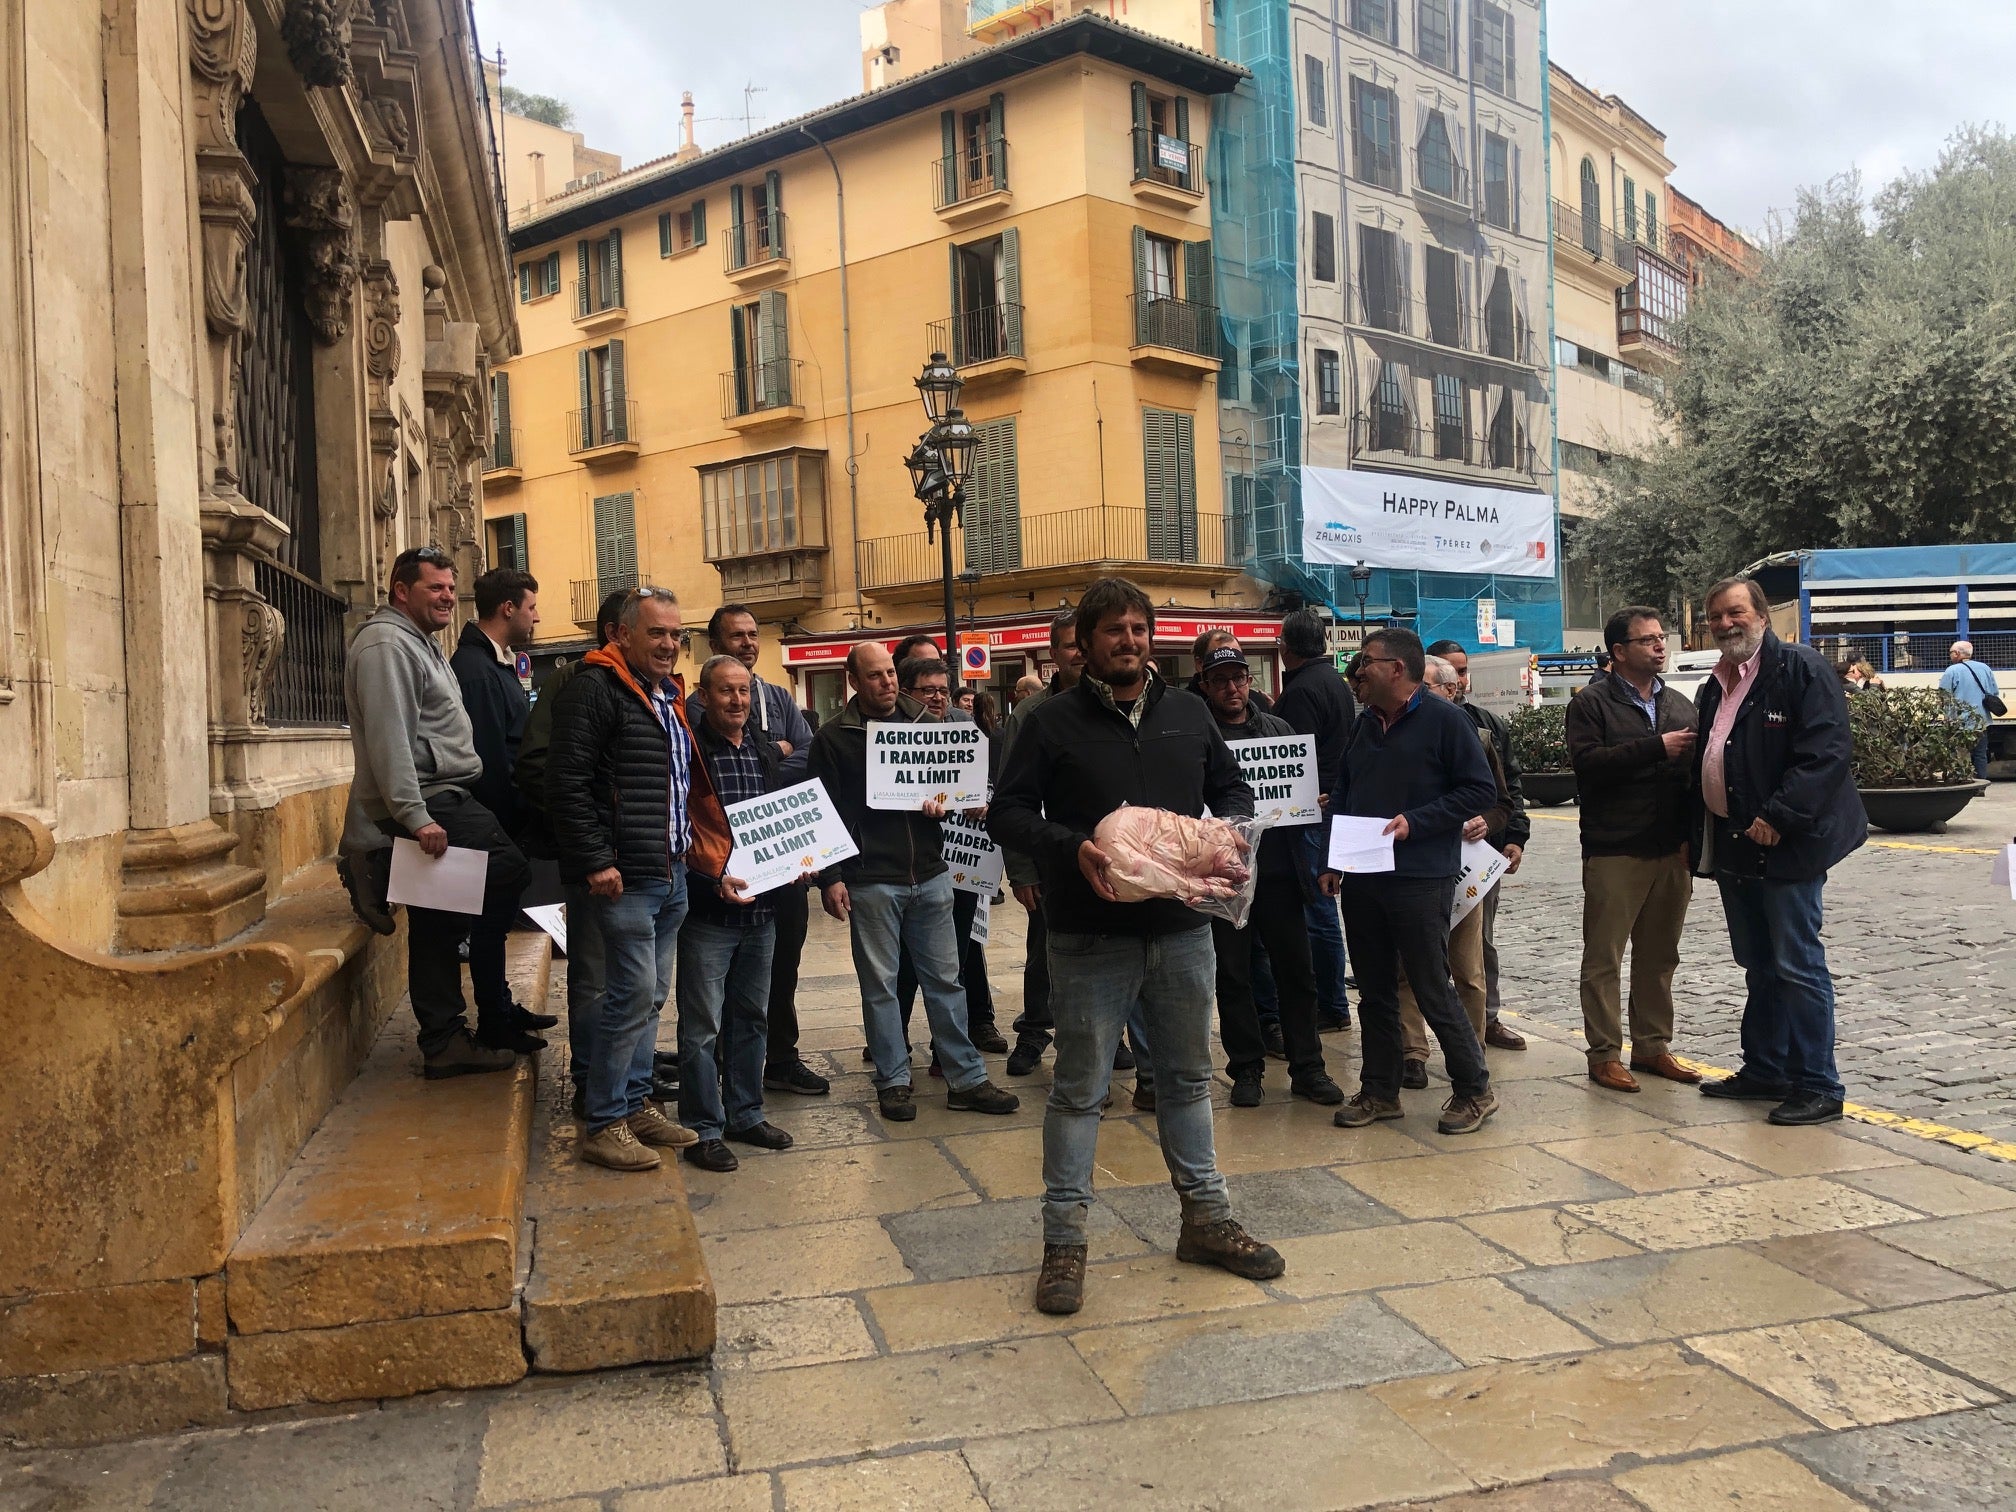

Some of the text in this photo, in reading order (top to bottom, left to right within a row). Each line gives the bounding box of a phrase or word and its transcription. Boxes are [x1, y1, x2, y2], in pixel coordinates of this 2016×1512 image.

[1383, 492, 1499, 523] HAPPY PALMA
[1315, 531, 1362, 543] ZALMOXIS
[990, 633, 1003, 645] ATI
[1021, 631, 1051, 640] PASTELERI
[875, 729, 979, 745] AGRICULTORS
[880, 749, 975, 764] I RAMADERS
[1235, 743, 1307, 763] ICULTORS
[895, 766, 960, 784] AL LÍMIT
[1241, 763, 1305, 781] MADERS
[739, 807, 823, 847] RAMADERS
[753, 829, 817, 864] AL LÍMIT
[944, 829, 996, 853] MADERS
[944, 847, 981, 867] LÍMIT
